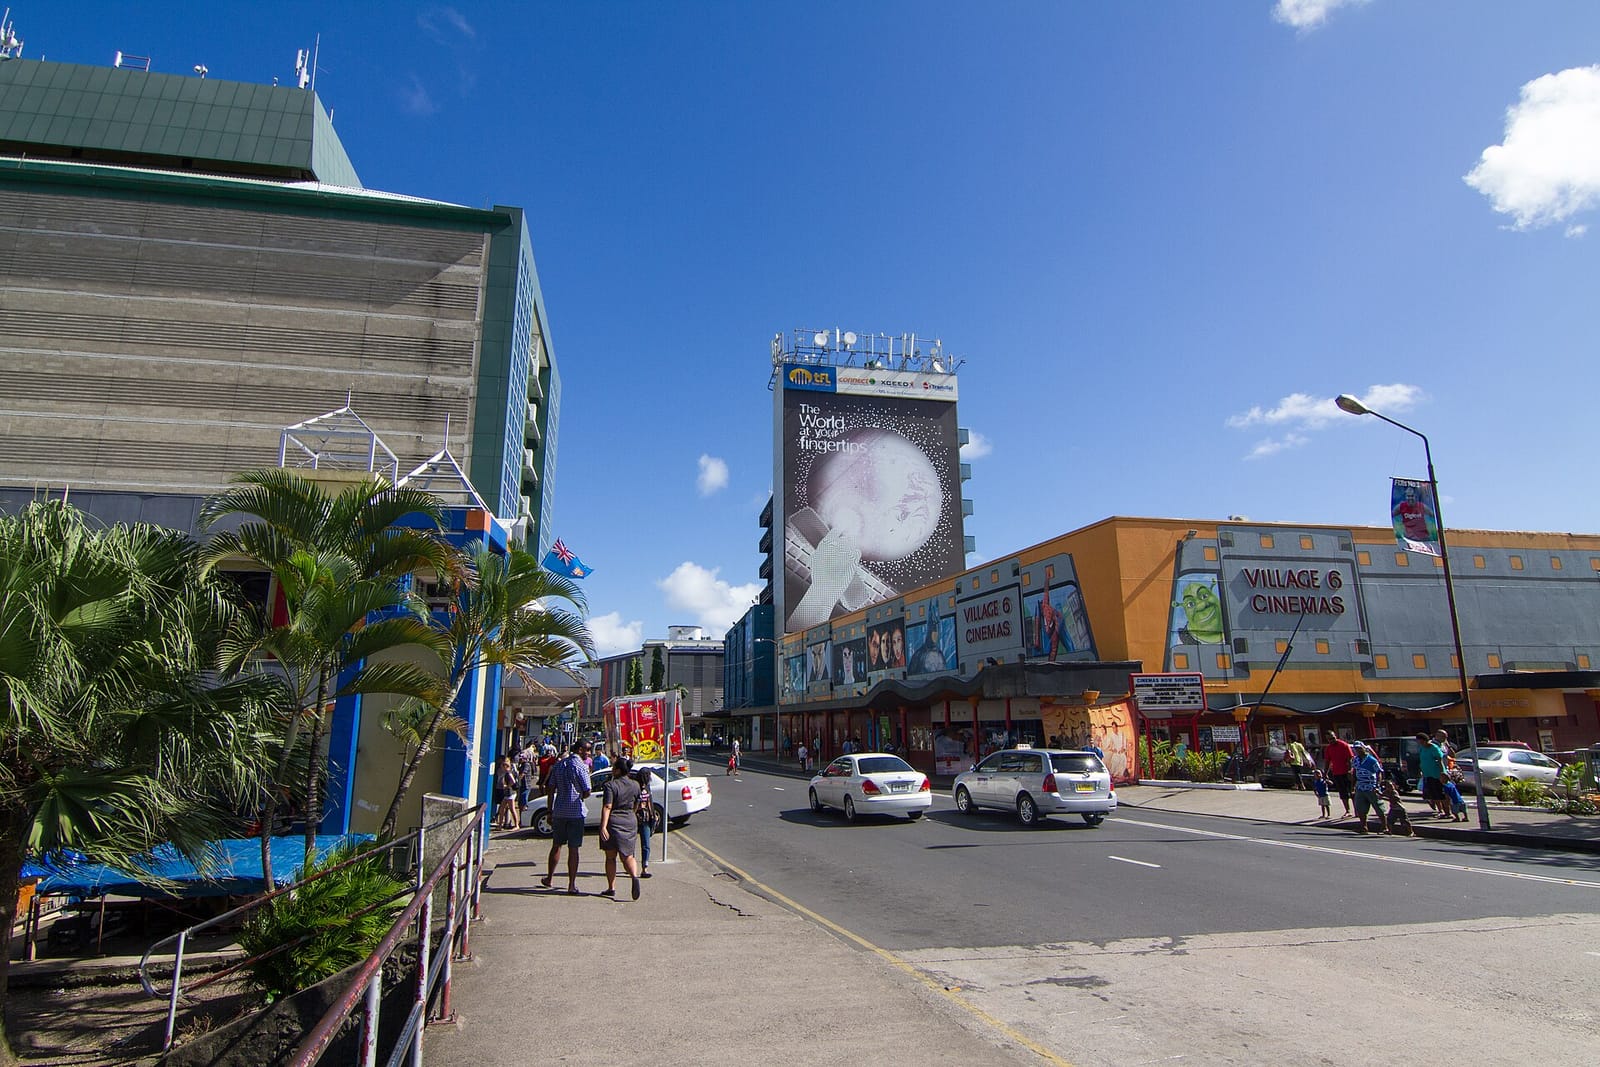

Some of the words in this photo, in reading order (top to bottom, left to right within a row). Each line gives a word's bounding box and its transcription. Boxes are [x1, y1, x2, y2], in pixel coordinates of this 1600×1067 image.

[800, 403, 820, 415] The
[799, 413, 845, 430] World
[799, 426, 810, 436] at
[800, 436, 868, 454] fingertips
[1243, 567, 1321, 589] VILLAGE
[1326, 568, 1343, 590] 6
[963, 599, 999, 623] VILLAGE
[1002, 596, 1012, 614] 6
[1251, 594, 1345, 614] CINEMAS
[965, 620, 1011, 644] CINEMAS
